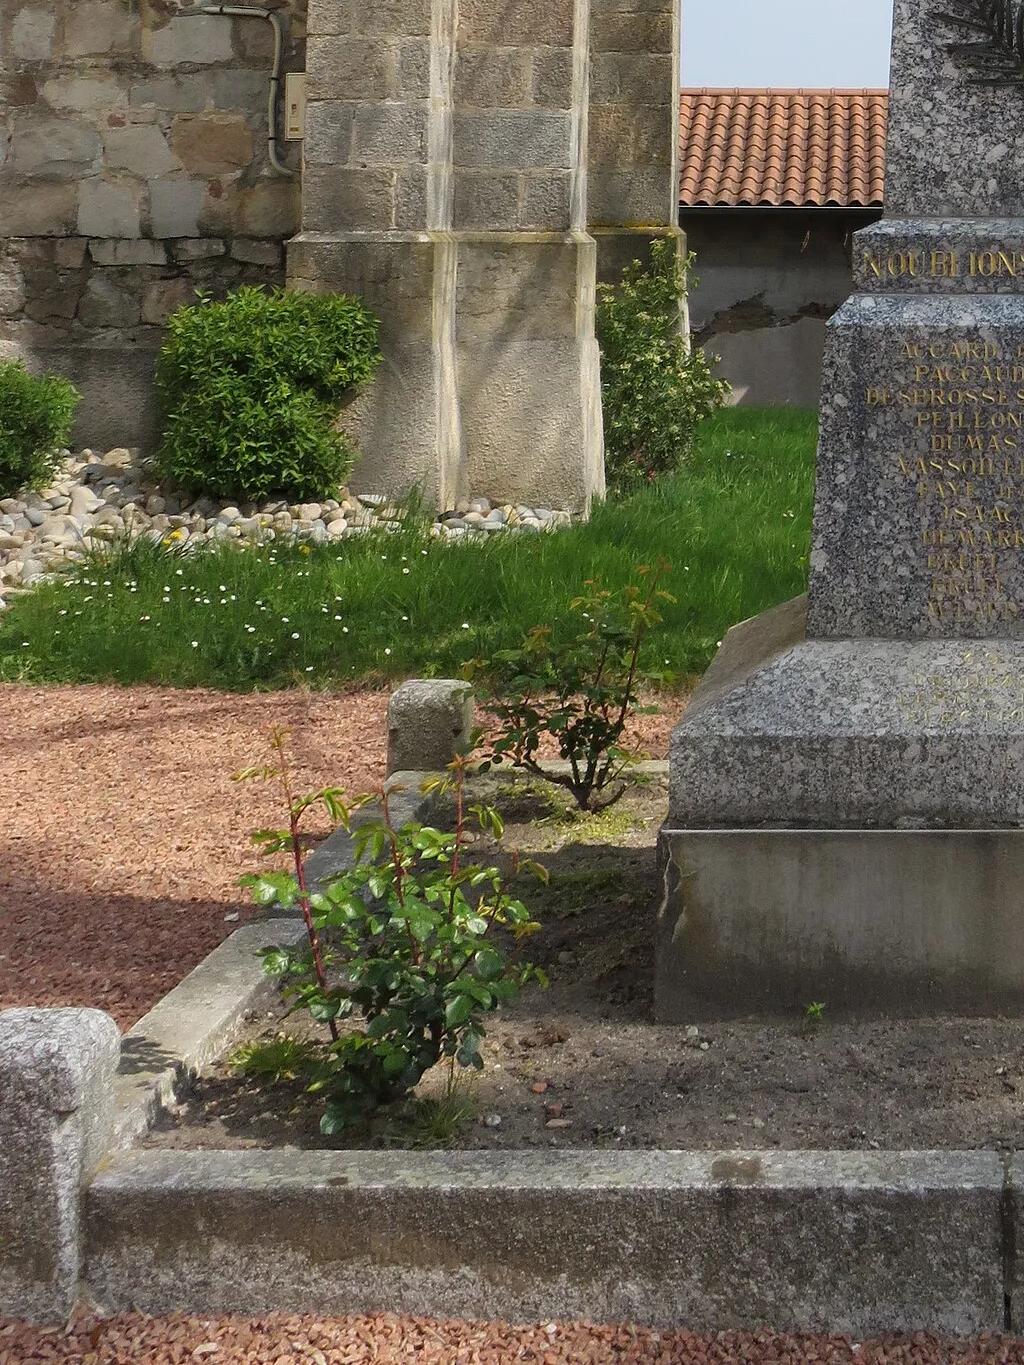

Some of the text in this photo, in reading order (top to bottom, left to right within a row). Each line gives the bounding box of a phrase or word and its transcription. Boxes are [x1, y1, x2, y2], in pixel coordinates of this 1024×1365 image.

[900, 342, 999, 359] ACCARD
[917, 411, 1024, 429] PEILLON
[931, 434, 1018, 452] DUMAS
